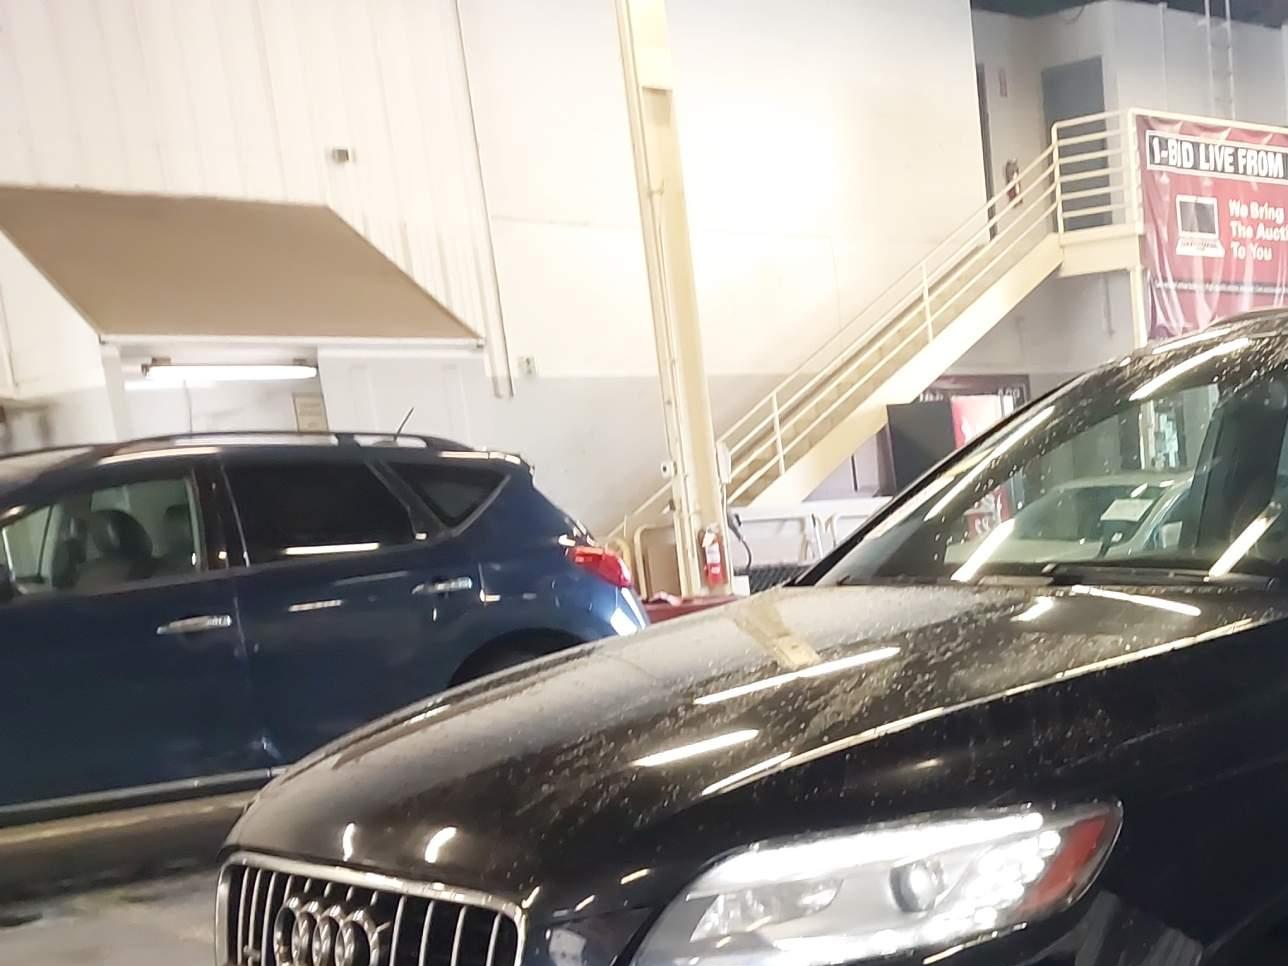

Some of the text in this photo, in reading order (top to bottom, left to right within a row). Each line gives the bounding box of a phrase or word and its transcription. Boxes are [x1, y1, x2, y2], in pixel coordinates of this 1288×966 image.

[1199, 144, 1235, 173] LIVE
[1238, 149, 1283, 178] FROM
[1229, 199, 1285, 224] We Bring
[1230, 220, 1254, 239] The
[1230, 241, 1272, 261] To You
